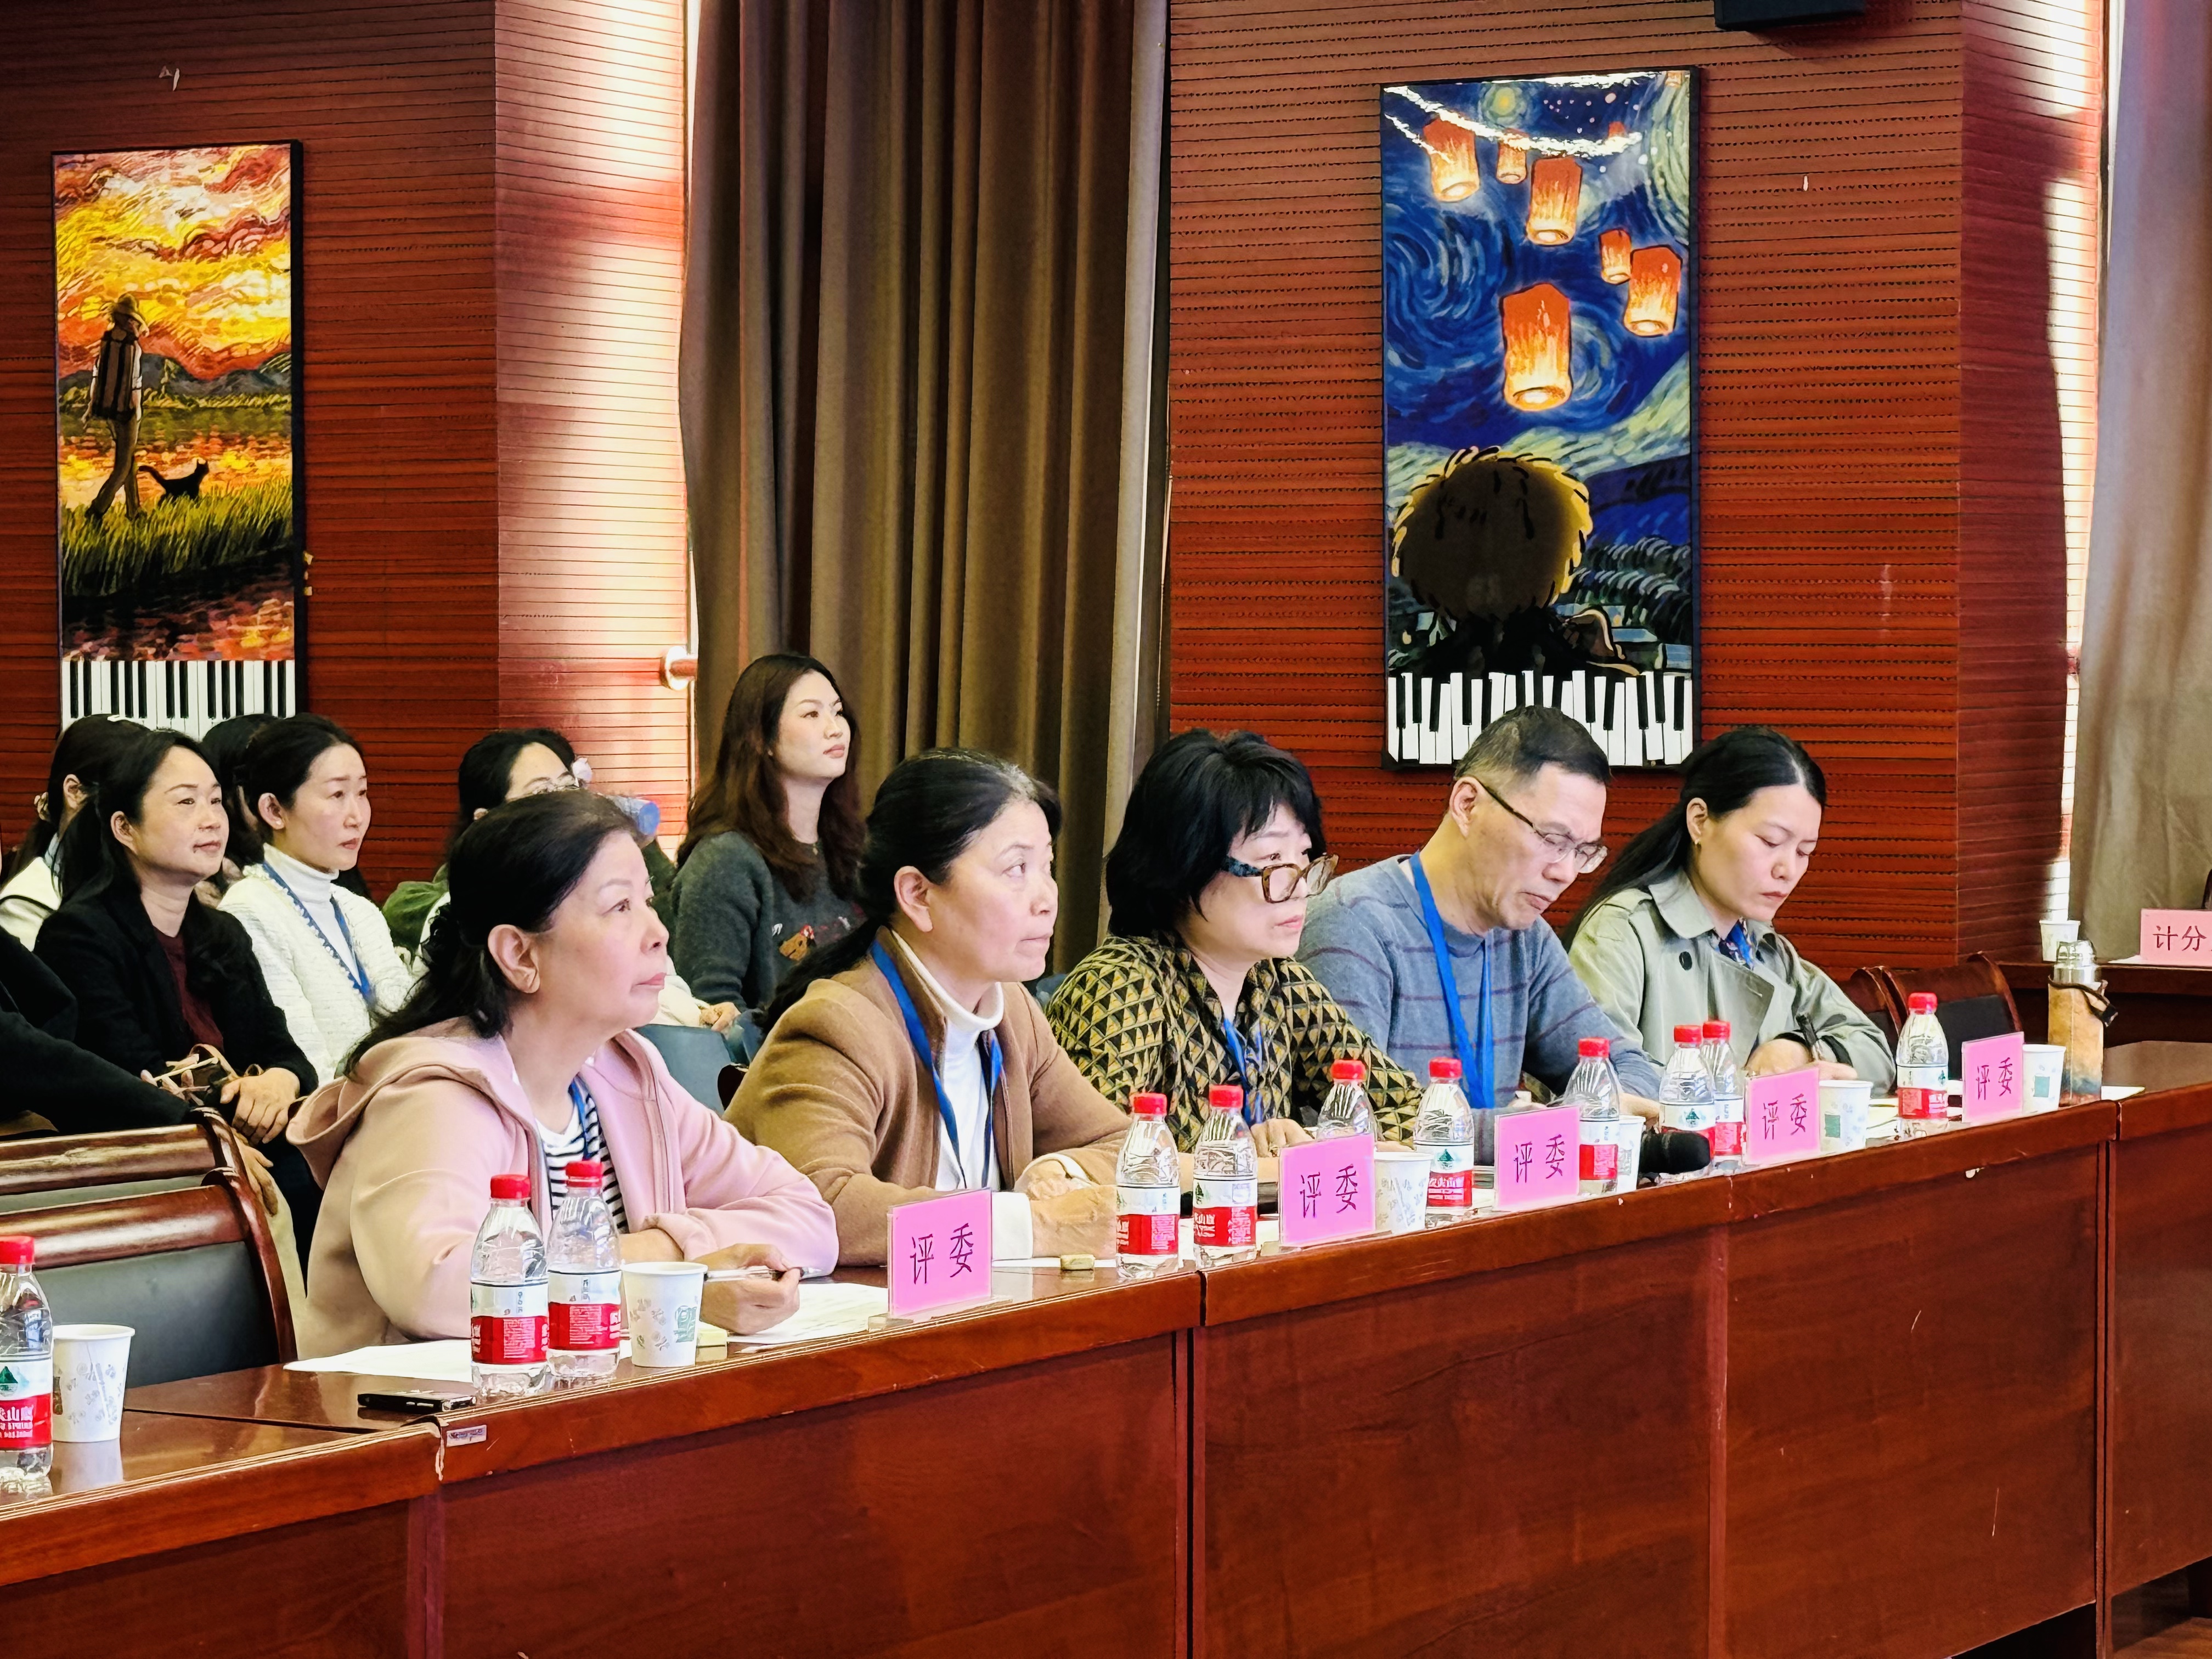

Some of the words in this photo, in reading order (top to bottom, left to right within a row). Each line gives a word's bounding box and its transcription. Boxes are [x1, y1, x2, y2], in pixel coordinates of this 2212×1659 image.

[2152, 926, 2212, 952] 计分
[1976, 1057, 2013, 1101] 评委
[1762, 1093, 1807, 1140] 评委
[1513, 1134, 1565, 1183] 评委
[1299, 1164, 1358, 1218] 评委
[910, 1222, 974, 1285] 评委
